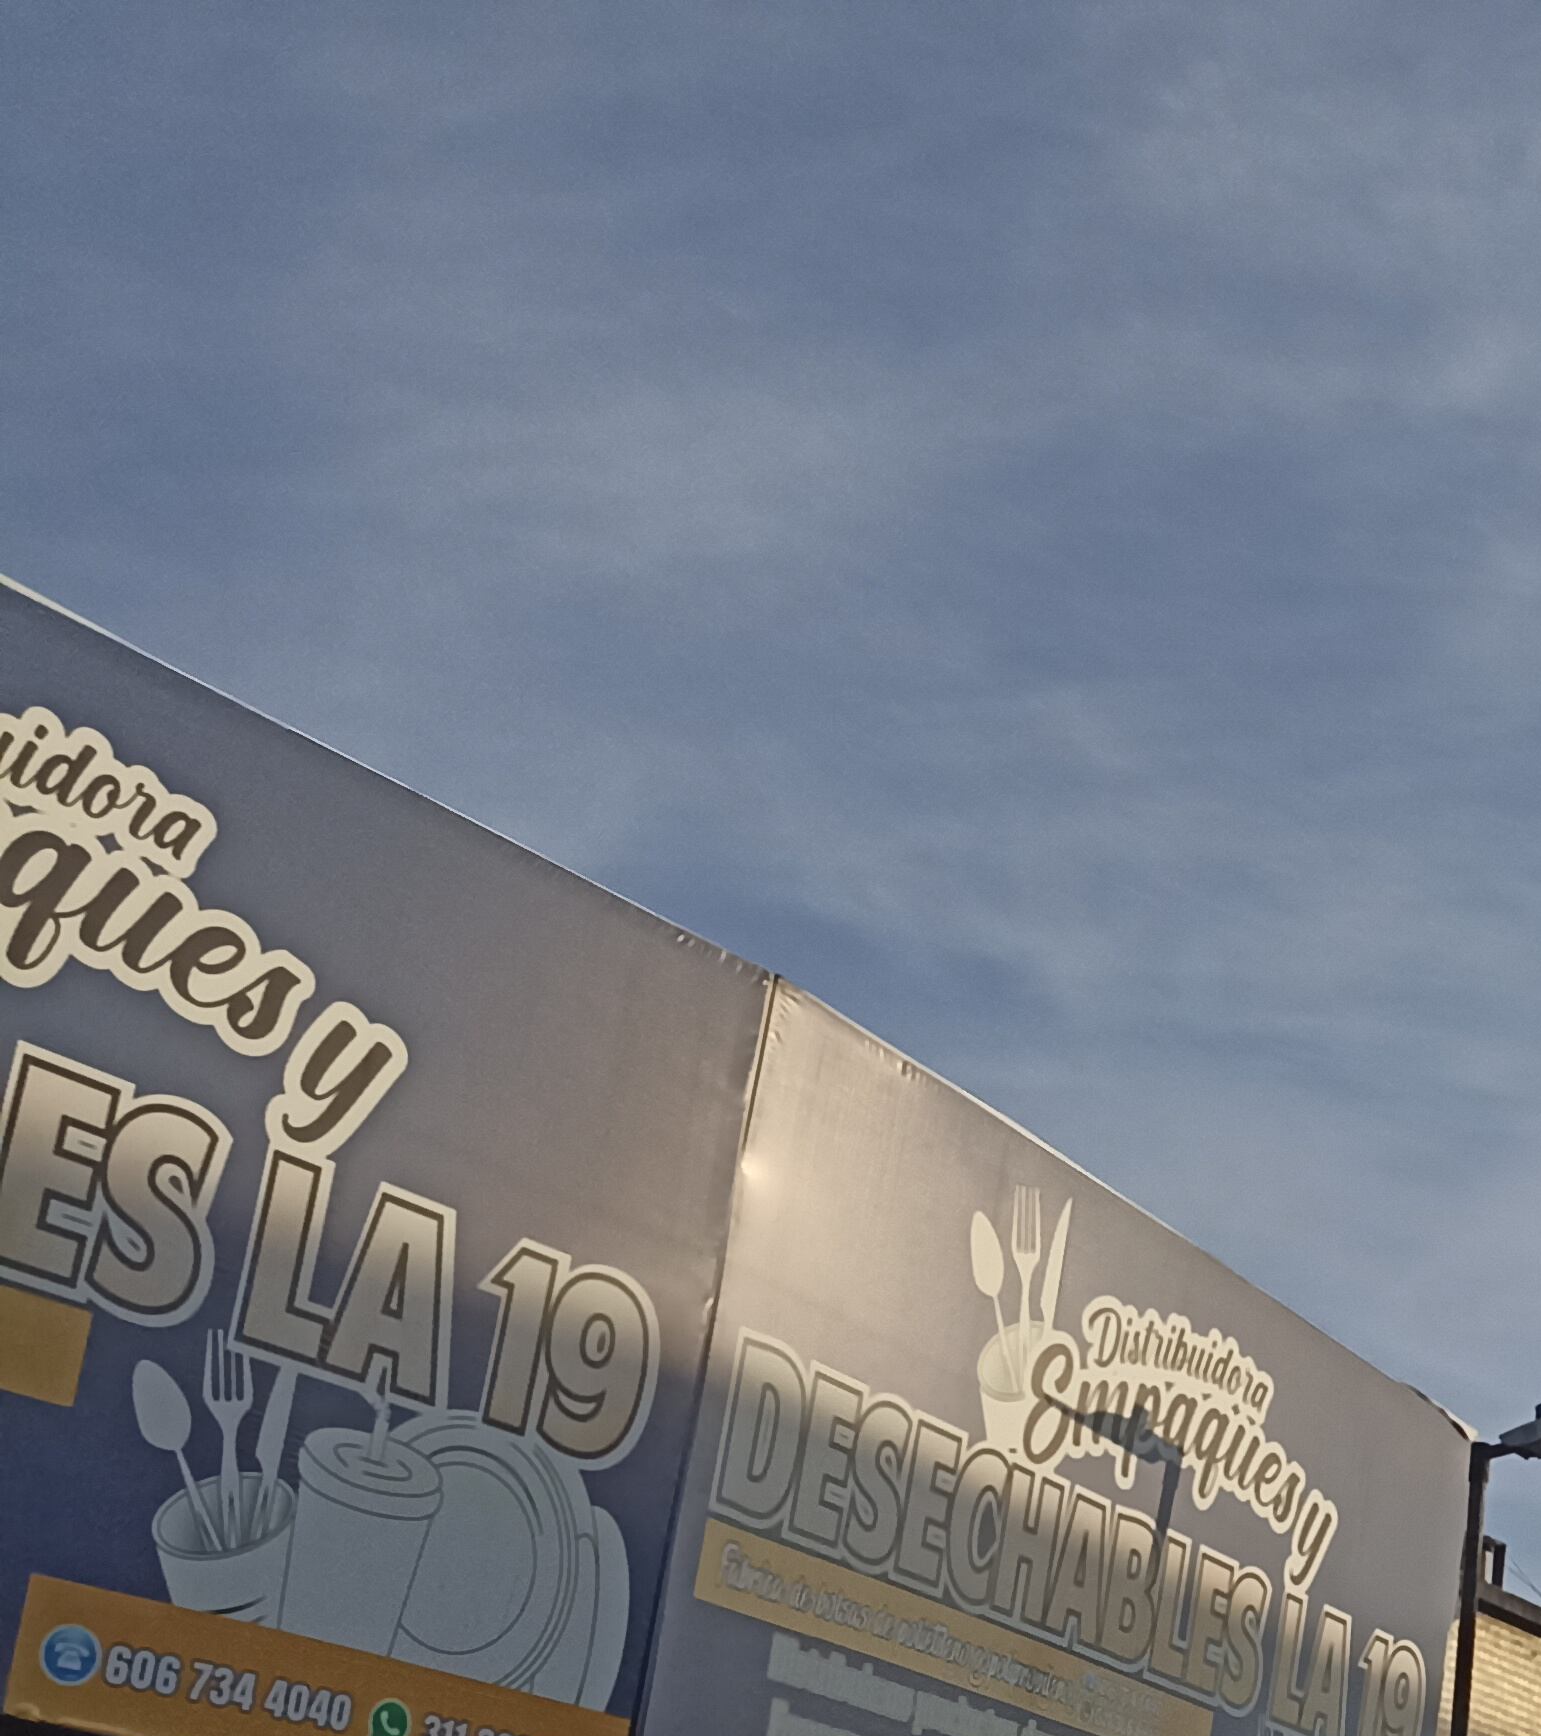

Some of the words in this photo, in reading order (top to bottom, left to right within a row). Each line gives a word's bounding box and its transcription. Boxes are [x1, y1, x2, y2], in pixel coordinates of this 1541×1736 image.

[282, 1019, 392, 1143] y
[238, 1149, 450, 1408] LA
[482, 1245, 650, 1461] 19
[1086, 1306, 1270, 1411] Distribuidora
[720, 1345, 1268, 1709] DESECHABLES
[1289, 1501, 1334, 1586] y
[105, 1643, 181, 1696] 606
[190, 1659, 259, 1712] 734
[263, 1679, 354, 1733] 4040
